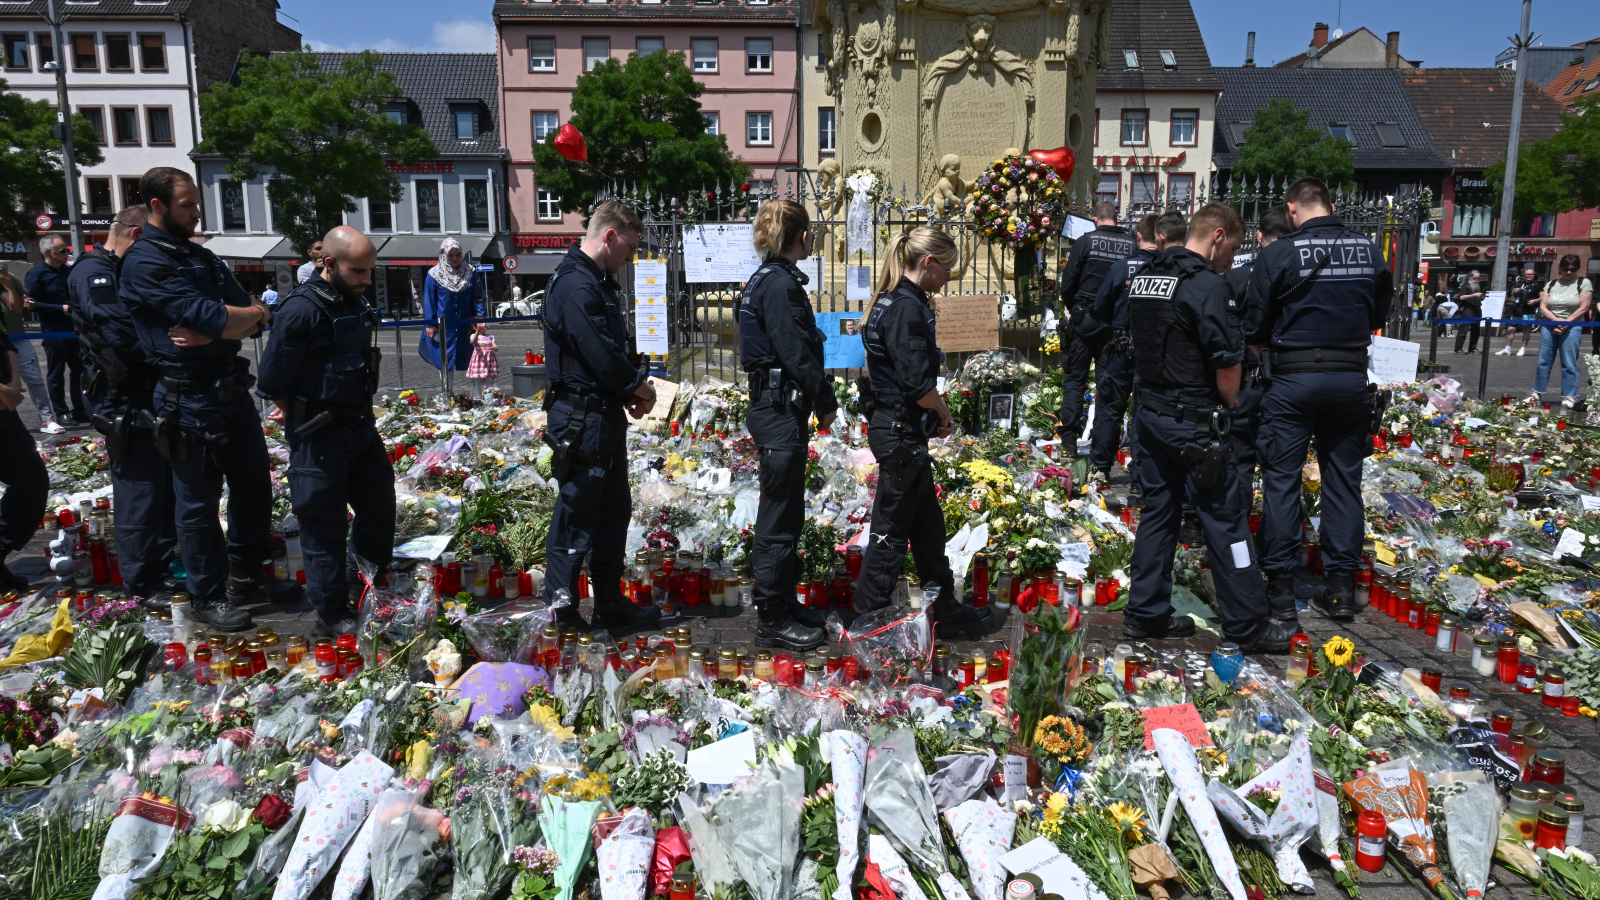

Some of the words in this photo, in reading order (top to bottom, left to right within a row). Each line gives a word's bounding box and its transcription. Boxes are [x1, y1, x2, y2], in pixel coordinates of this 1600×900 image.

[1462, 178, 1488, 187] Braut
[1092, 239, 1133, 256] POLIZEI
[1299, 246, 1373, 266] POLIZEI
[1131, 278, 1175, 297] POLIZEI
[138, 805, 174, 823] Roses
